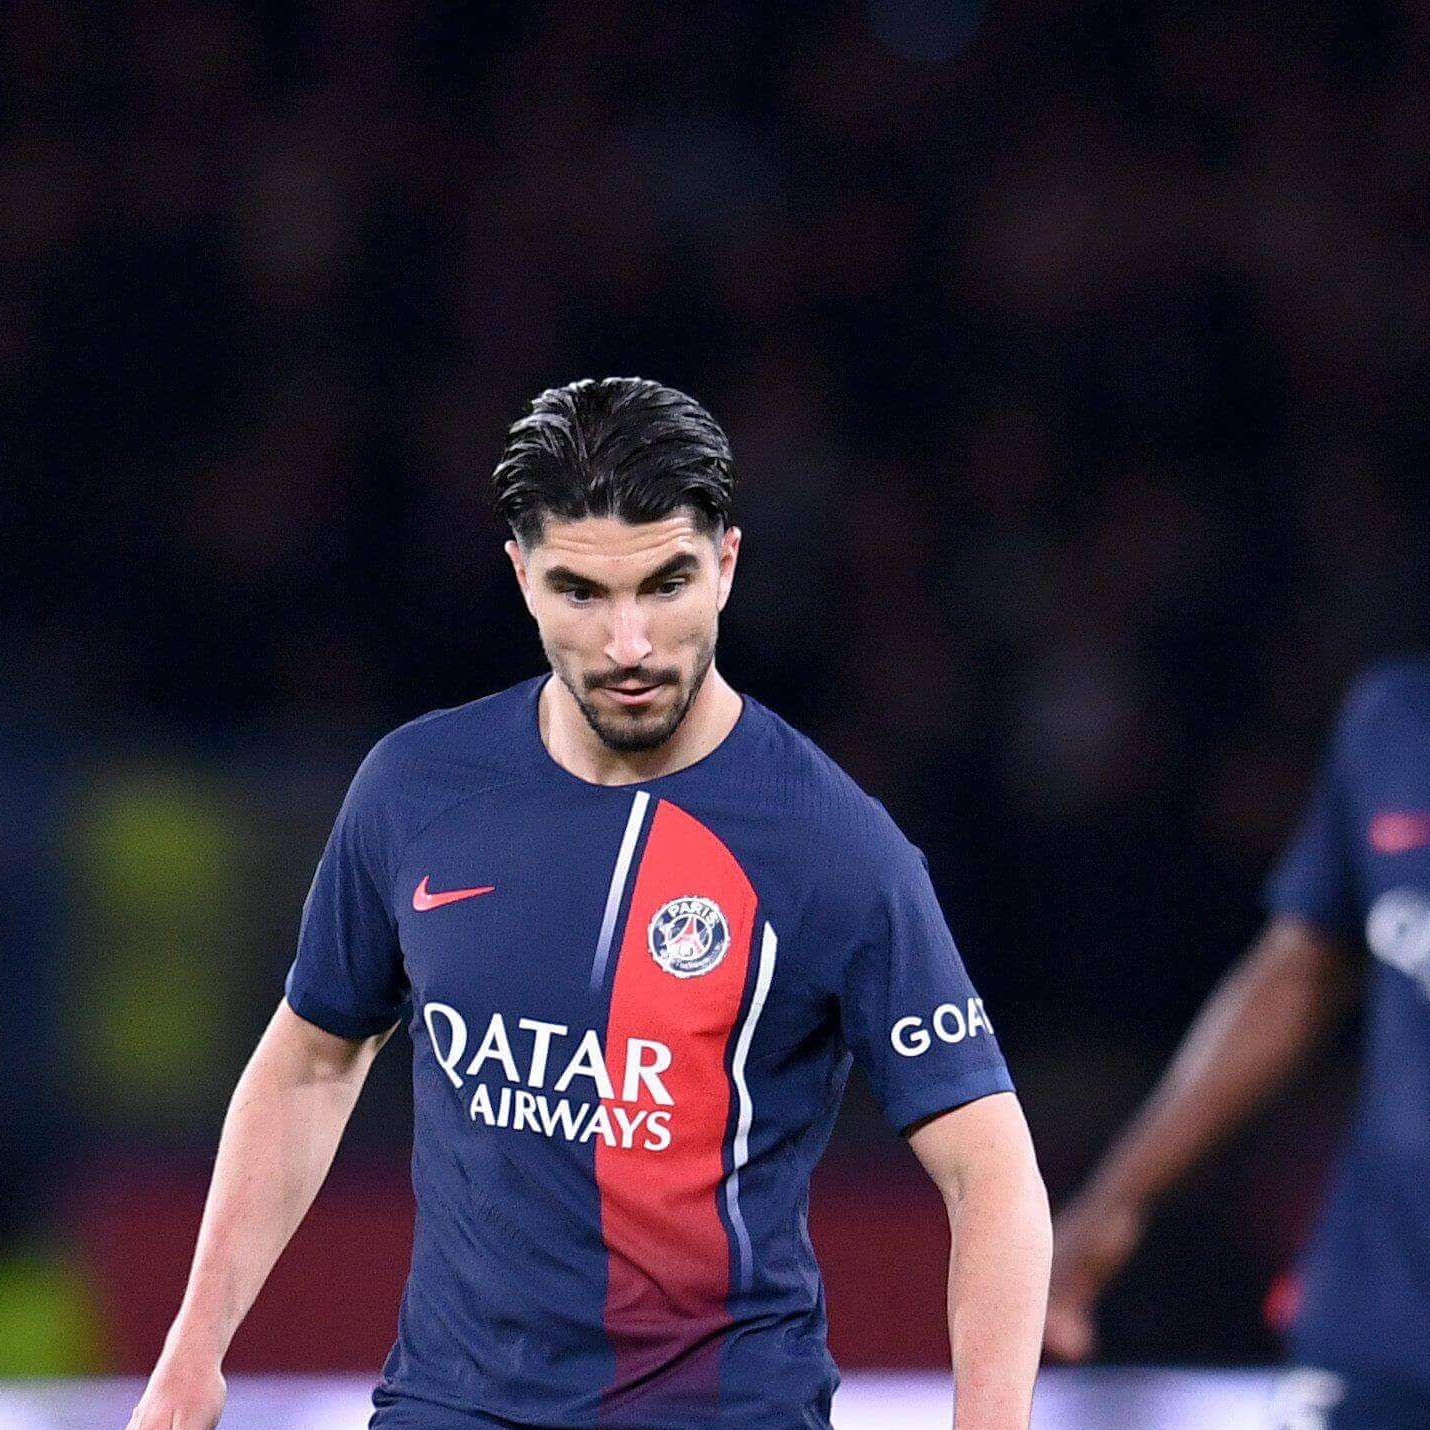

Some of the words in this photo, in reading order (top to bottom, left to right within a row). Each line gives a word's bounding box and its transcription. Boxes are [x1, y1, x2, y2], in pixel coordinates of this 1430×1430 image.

[668, 901, 720, 929] PARIS
[423, 1002, 675, 1106] QATAR
[470, 1084, 672, 1151] AIRWAYS
